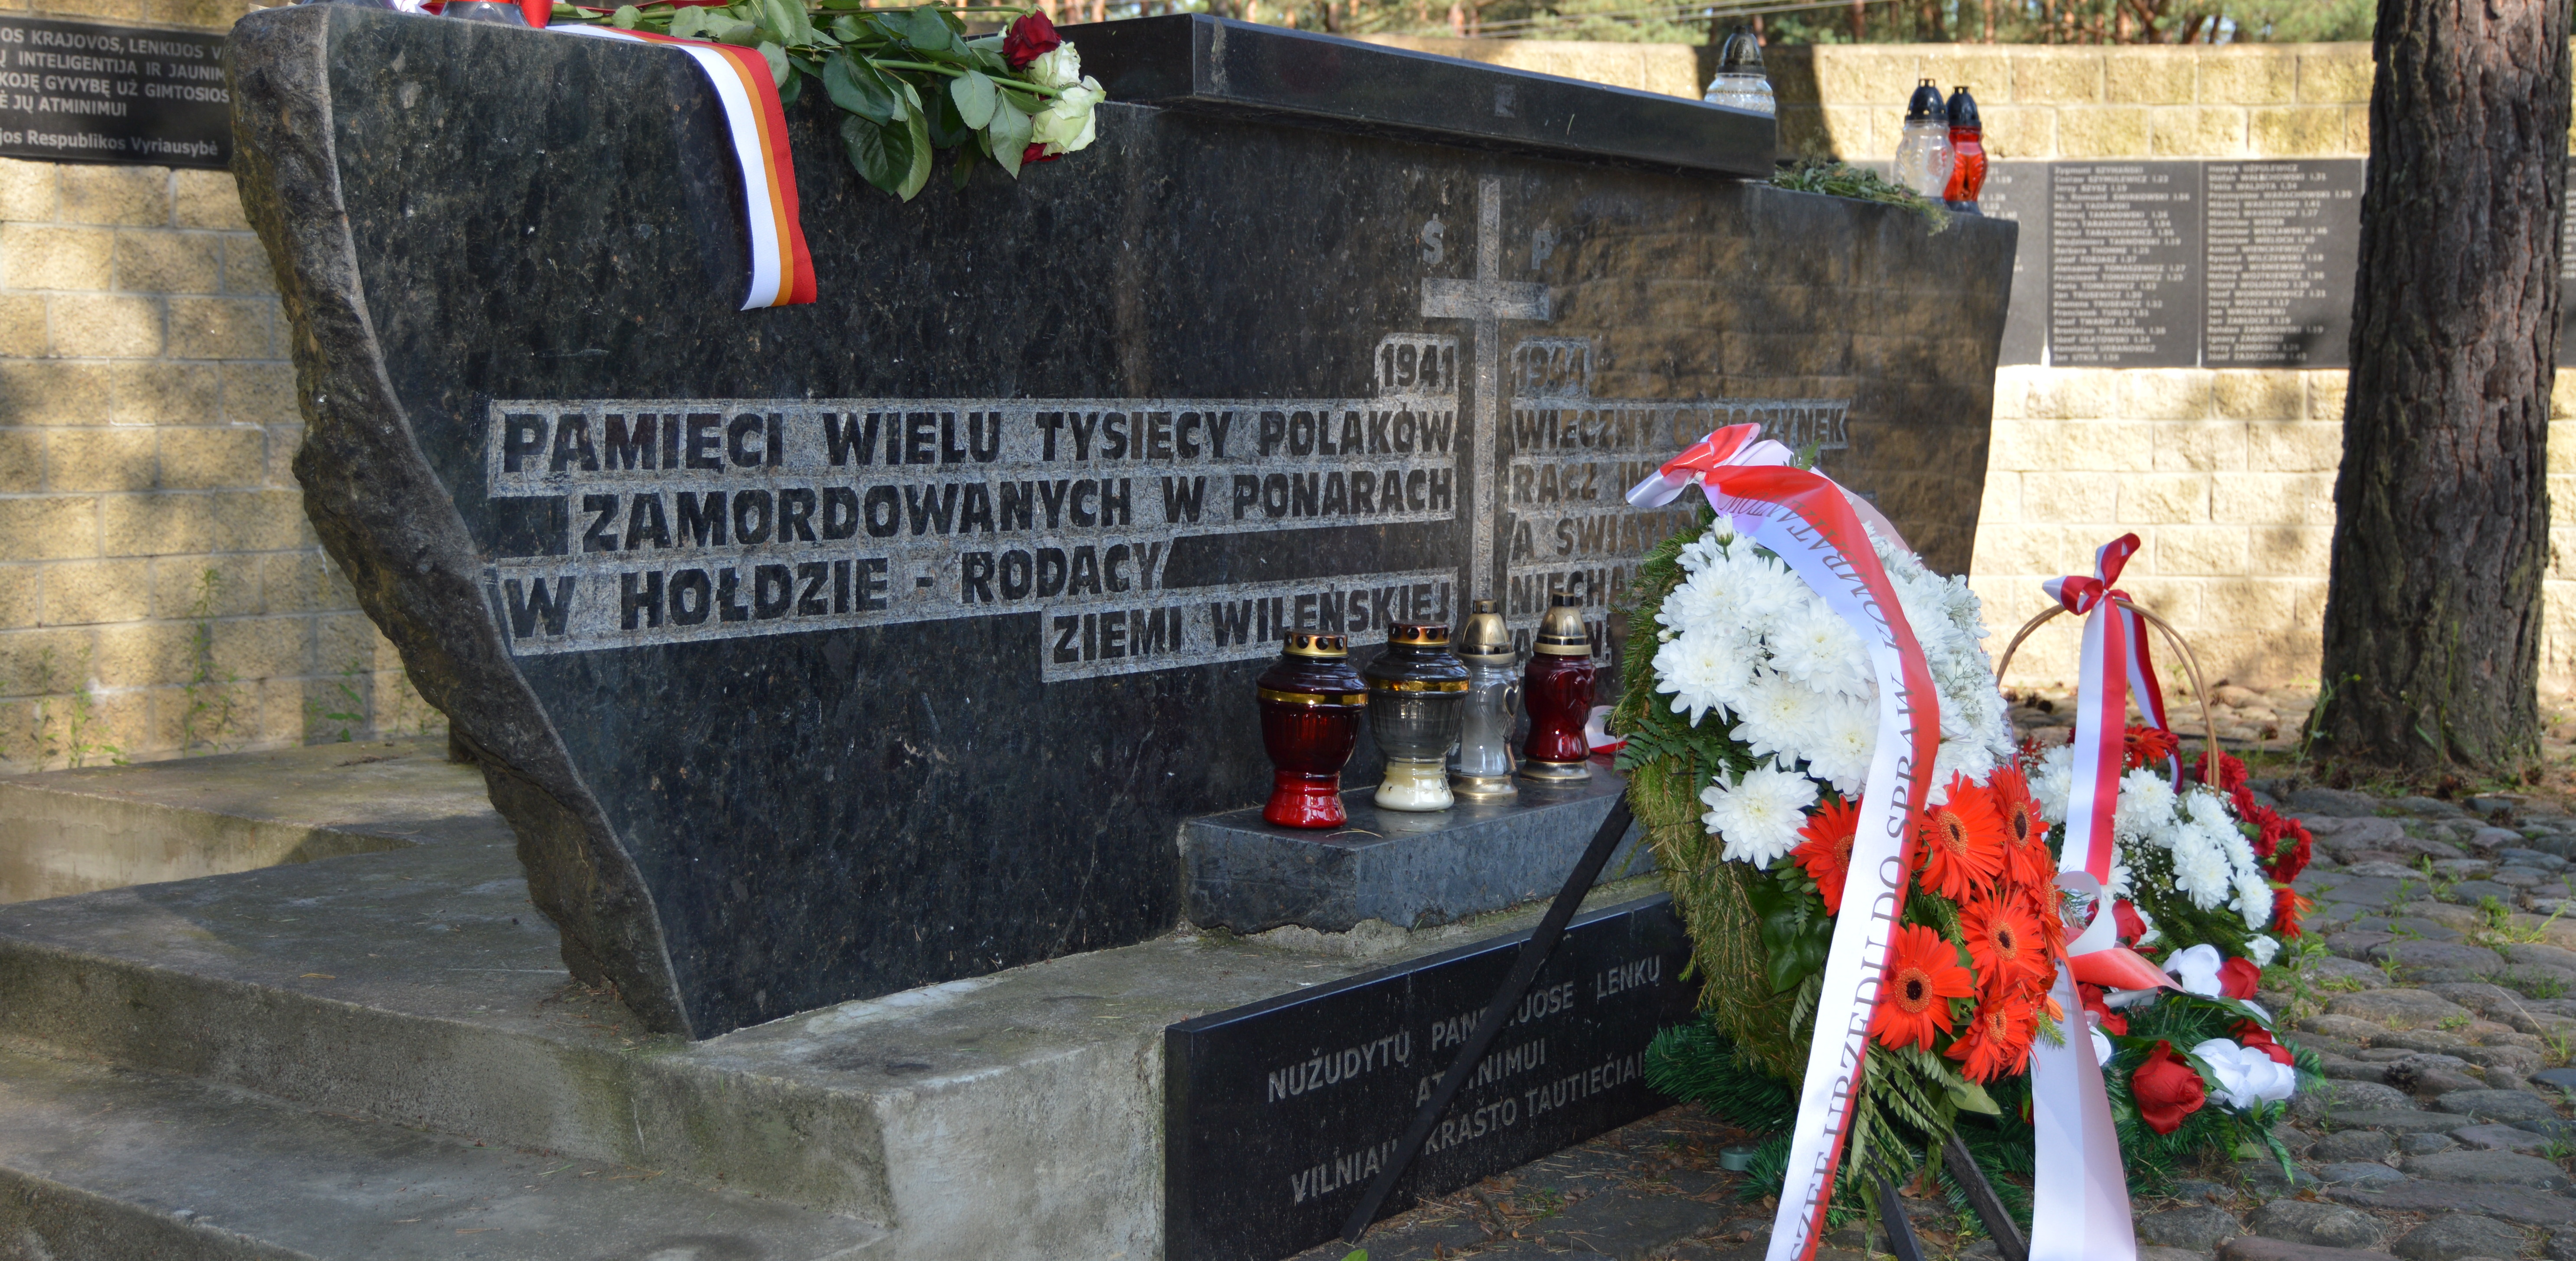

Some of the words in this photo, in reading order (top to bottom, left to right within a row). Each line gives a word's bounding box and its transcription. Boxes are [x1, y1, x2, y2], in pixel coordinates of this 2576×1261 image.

[18, 51, 138, 75] INTELIGENTIJA
[145, 62, 161, 77] IR
[31, 31, 125, 55] KRAJOVOS,
[129, 39, 204, 59] LENKIJOS
[12, 93, 33, 114] JŲ
[39, 96, 127, 117] ATMINIMUI
[45, 75, 111, 98] GYVYBĘ
[117, 78, 139, 96] UŽ
[144, 85, 230, 104] GIMTOSIOS
[27, 129, 126, 150] Respublikos
[130, 136, 218, 157] Vyriausybė
[1382, 343, 1455, 388] 1941
[503, 411, 783, 474] PAMIĘCI
[822, 410, 1001, 467] WIELU
[1036, 410, 1234, 463] TYSIĘCY
[1259, 402, 1454, 457] POLAKÓW
[1515, 408, 1658, 454] WIECZNY
[1514, 461, 1598, 505] RACZ
[582, 477, 1131, 553] ZAMORDOWANYCH
[1161, 475, 1206, 523] W
[1233, 468, 1453, 520] PONARACH
[1512, 518, 1534, 560] A
[503, 575, 576, 639] W
[619, 557, 888, 631] HOŁDZIE
[960, 541, 1163, 605] RODACY
[1052, 607, 1182, 664] ZIEMI
[1215, 581, 1451, 648] WILEŃSKIEJ
[1886, 671, 1919, 844] SPRAW
[1871, 855, 1907, 922] DO
[1267, 1029, 1412, 1104] NUŽUDYTŲ
[1596, 954, 1661, 1000] LENKŲ
[1524, 1050, 1643, 1118] TAUTIEČIAI
